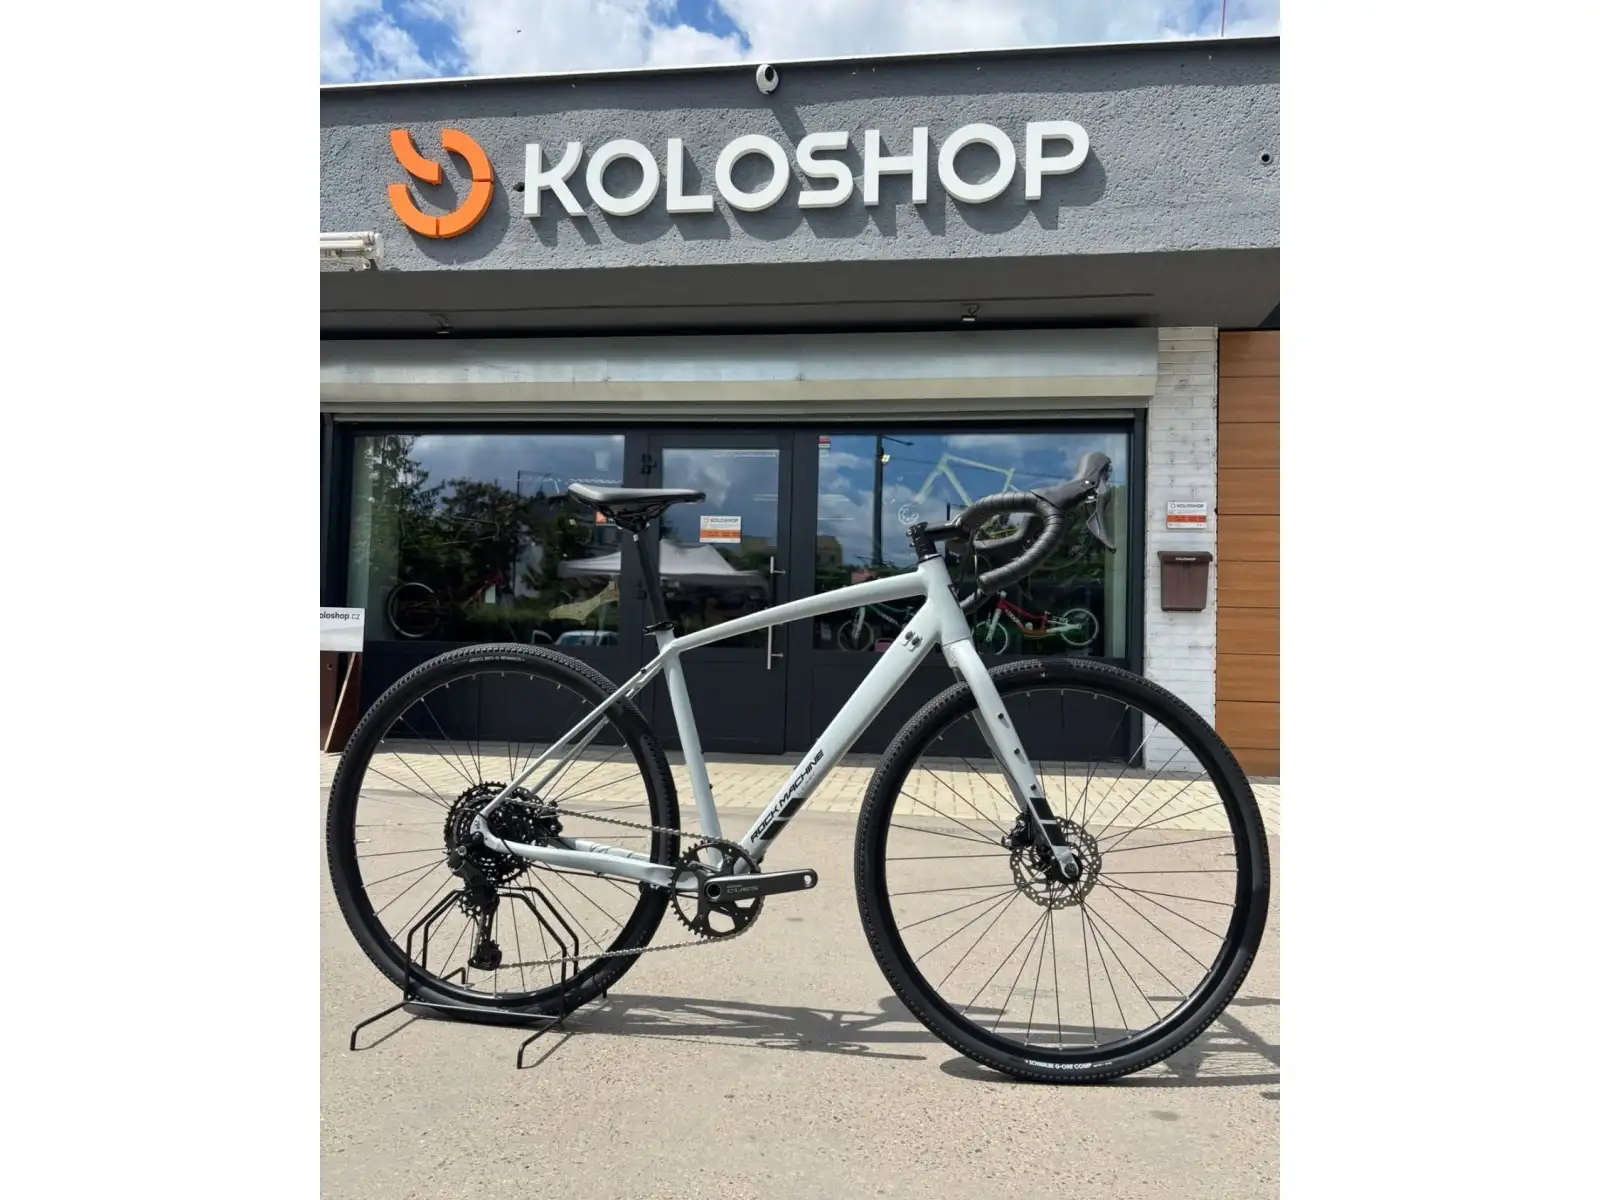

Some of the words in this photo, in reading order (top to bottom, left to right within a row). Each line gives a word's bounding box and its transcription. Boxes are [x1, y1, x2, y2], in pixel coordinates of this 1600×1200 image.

[524, 120, 1090, 217] KOLOSHOP
[751, 804, 780, 843] ROCK
[779, 749, 824, 808] MACHINE
